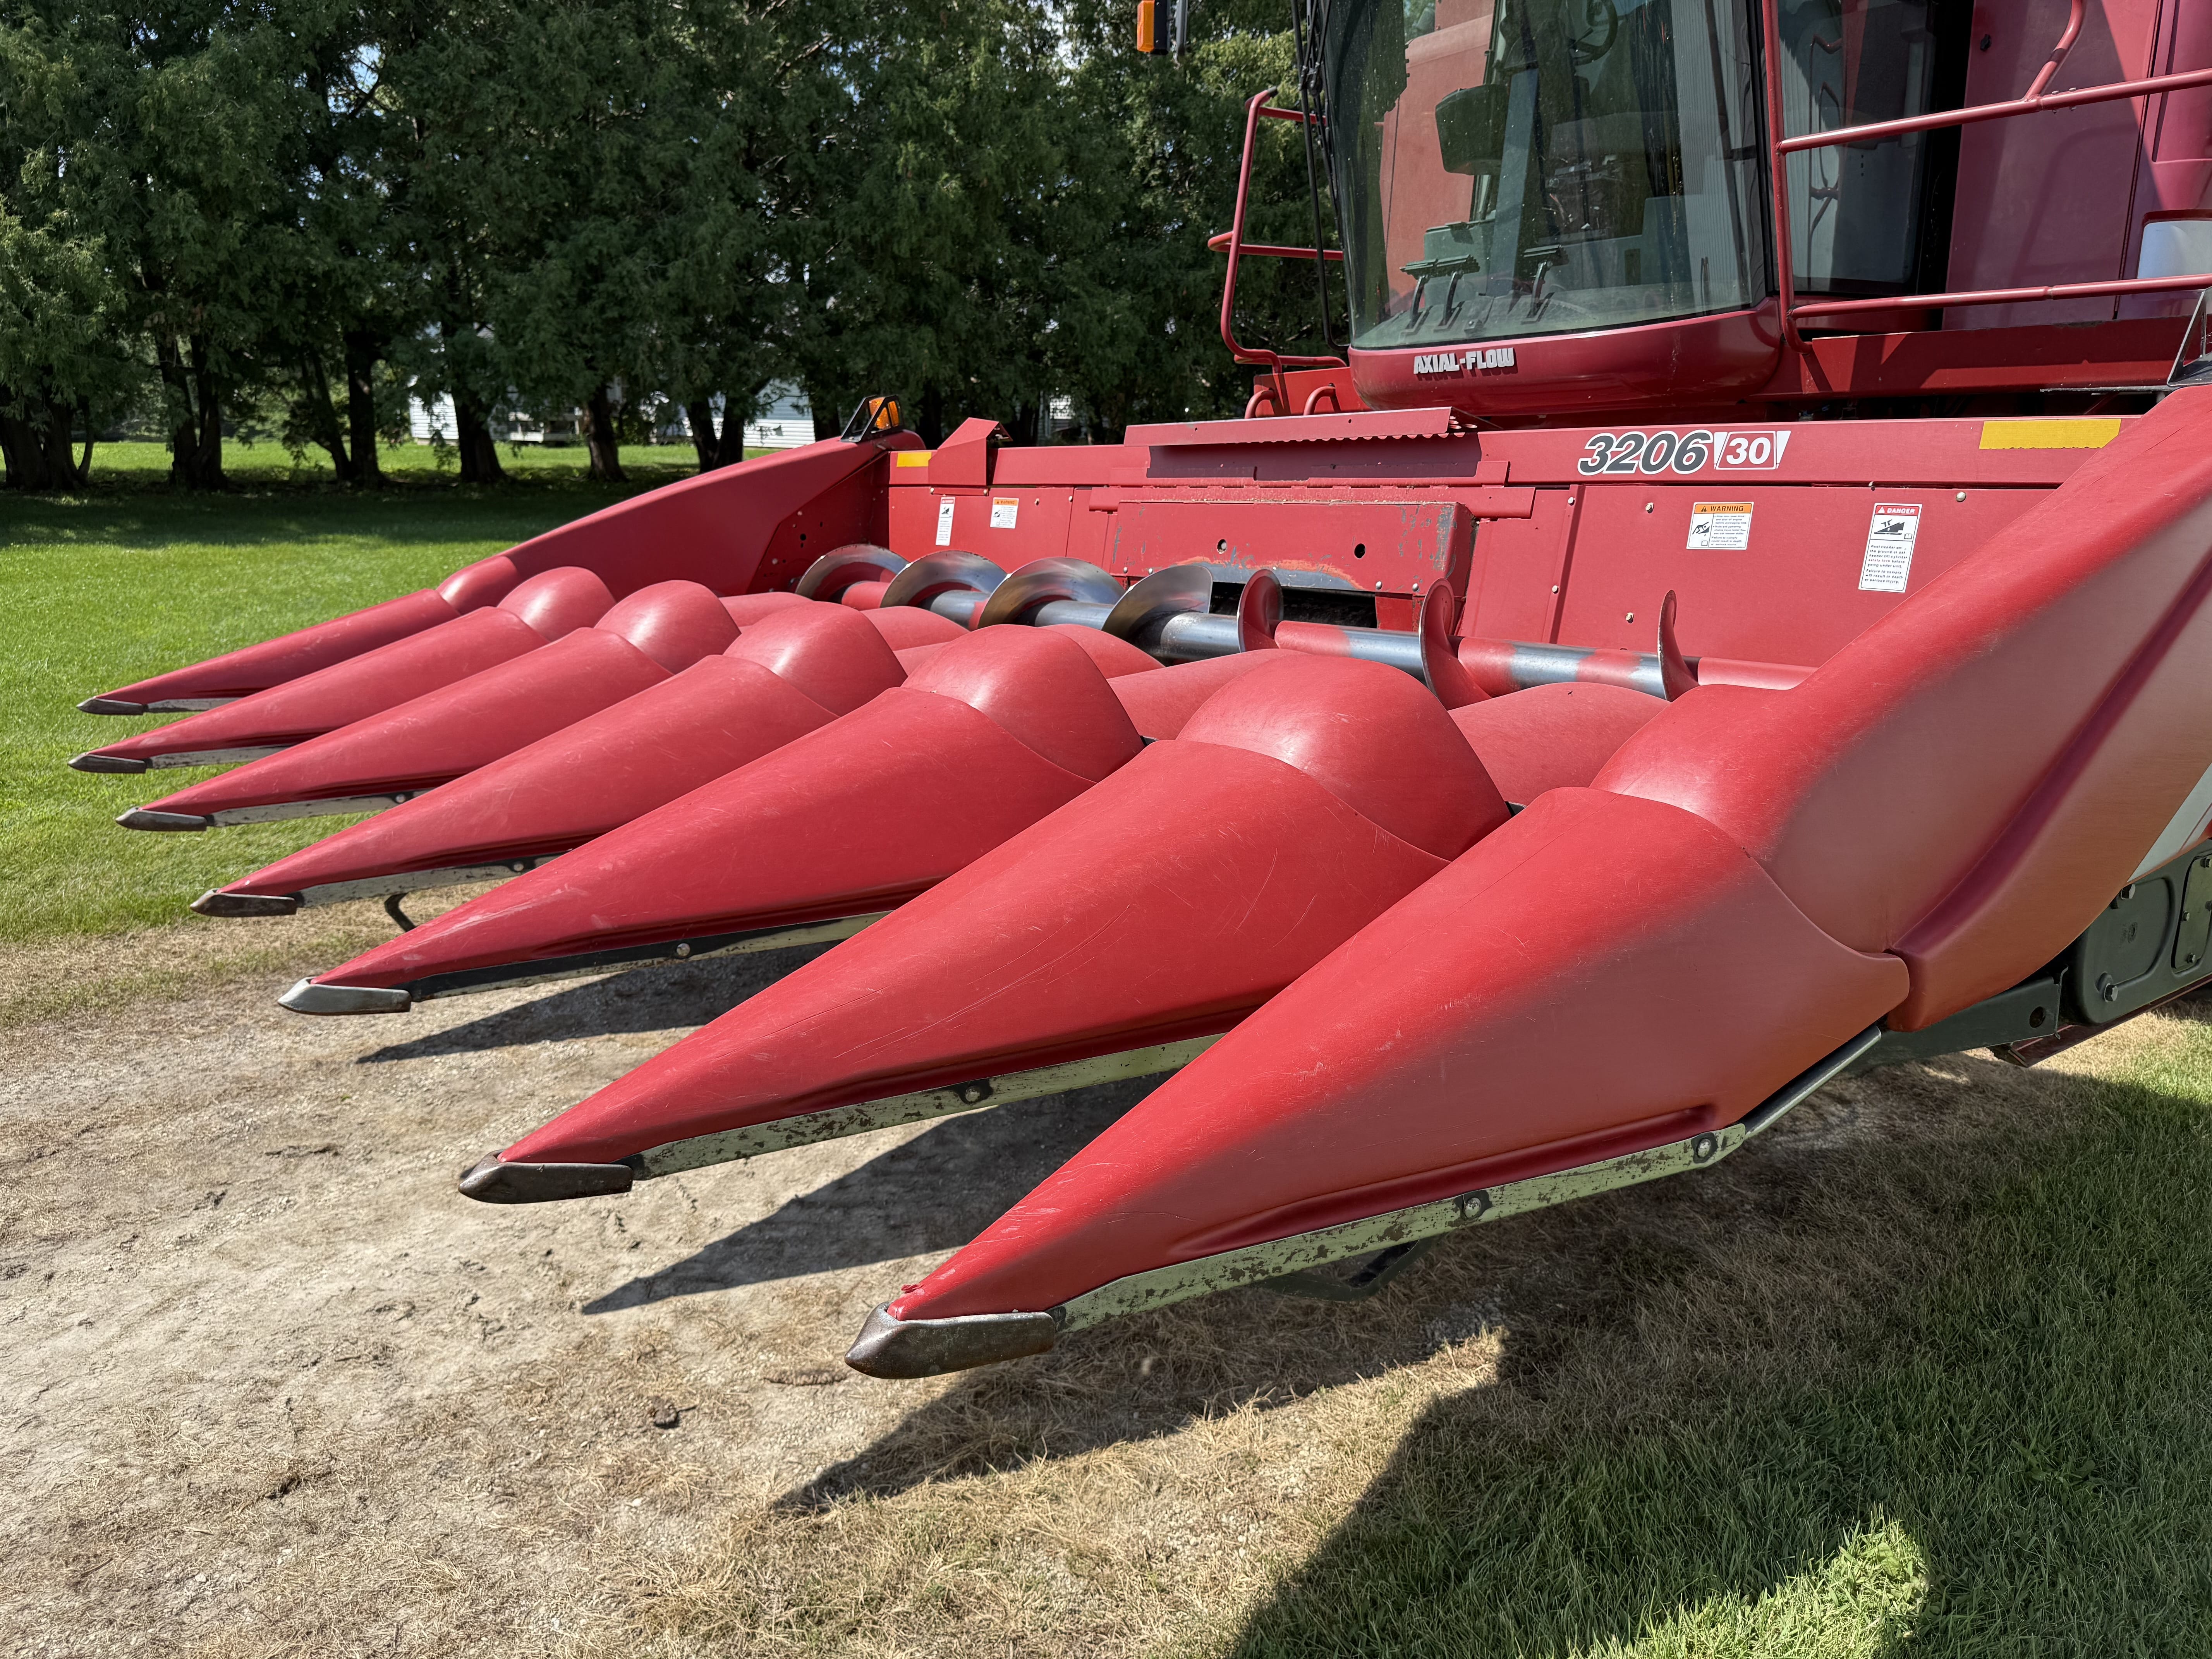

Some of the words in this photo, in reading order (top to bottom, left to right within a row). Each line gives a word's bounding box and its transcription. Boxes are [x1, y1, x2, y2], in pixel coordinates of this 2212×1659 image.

[1413, 347, 1515, 374] AXIAL-FLOW
[1577, 429, 1713, 476] 3206
[1726, 437, 1771, 464] 30
